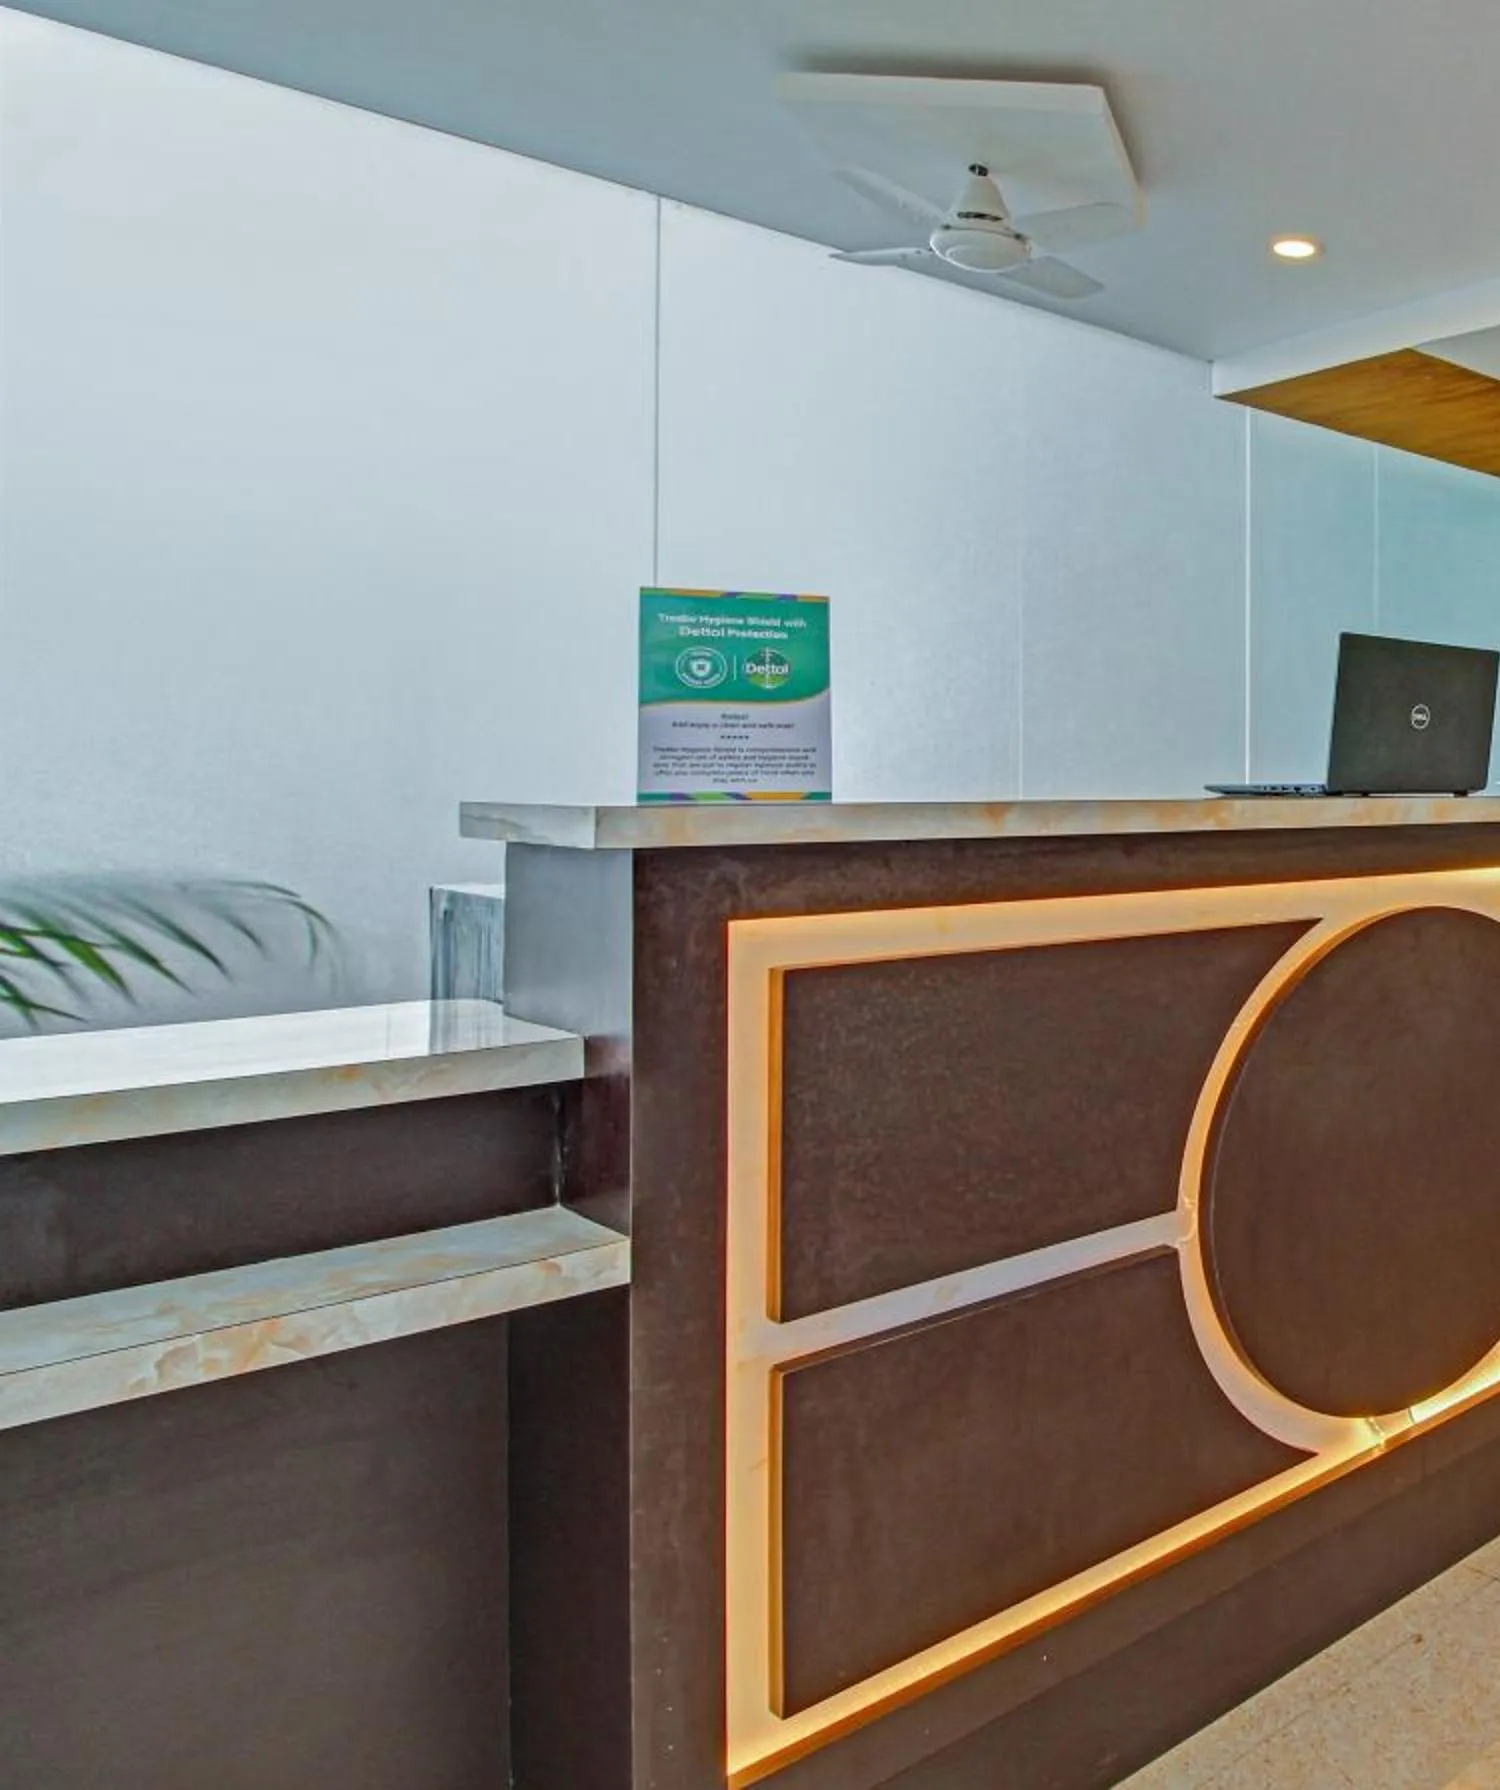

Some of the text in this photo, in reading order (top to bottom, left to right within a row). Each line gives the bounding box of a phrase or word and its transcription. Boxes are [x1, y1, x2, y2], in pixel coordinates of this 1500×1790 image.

[784, 618, 807, 628] with
[678, 626, 788, 640] Dettol Protection
[745, 662, 789, 675] Dettol
